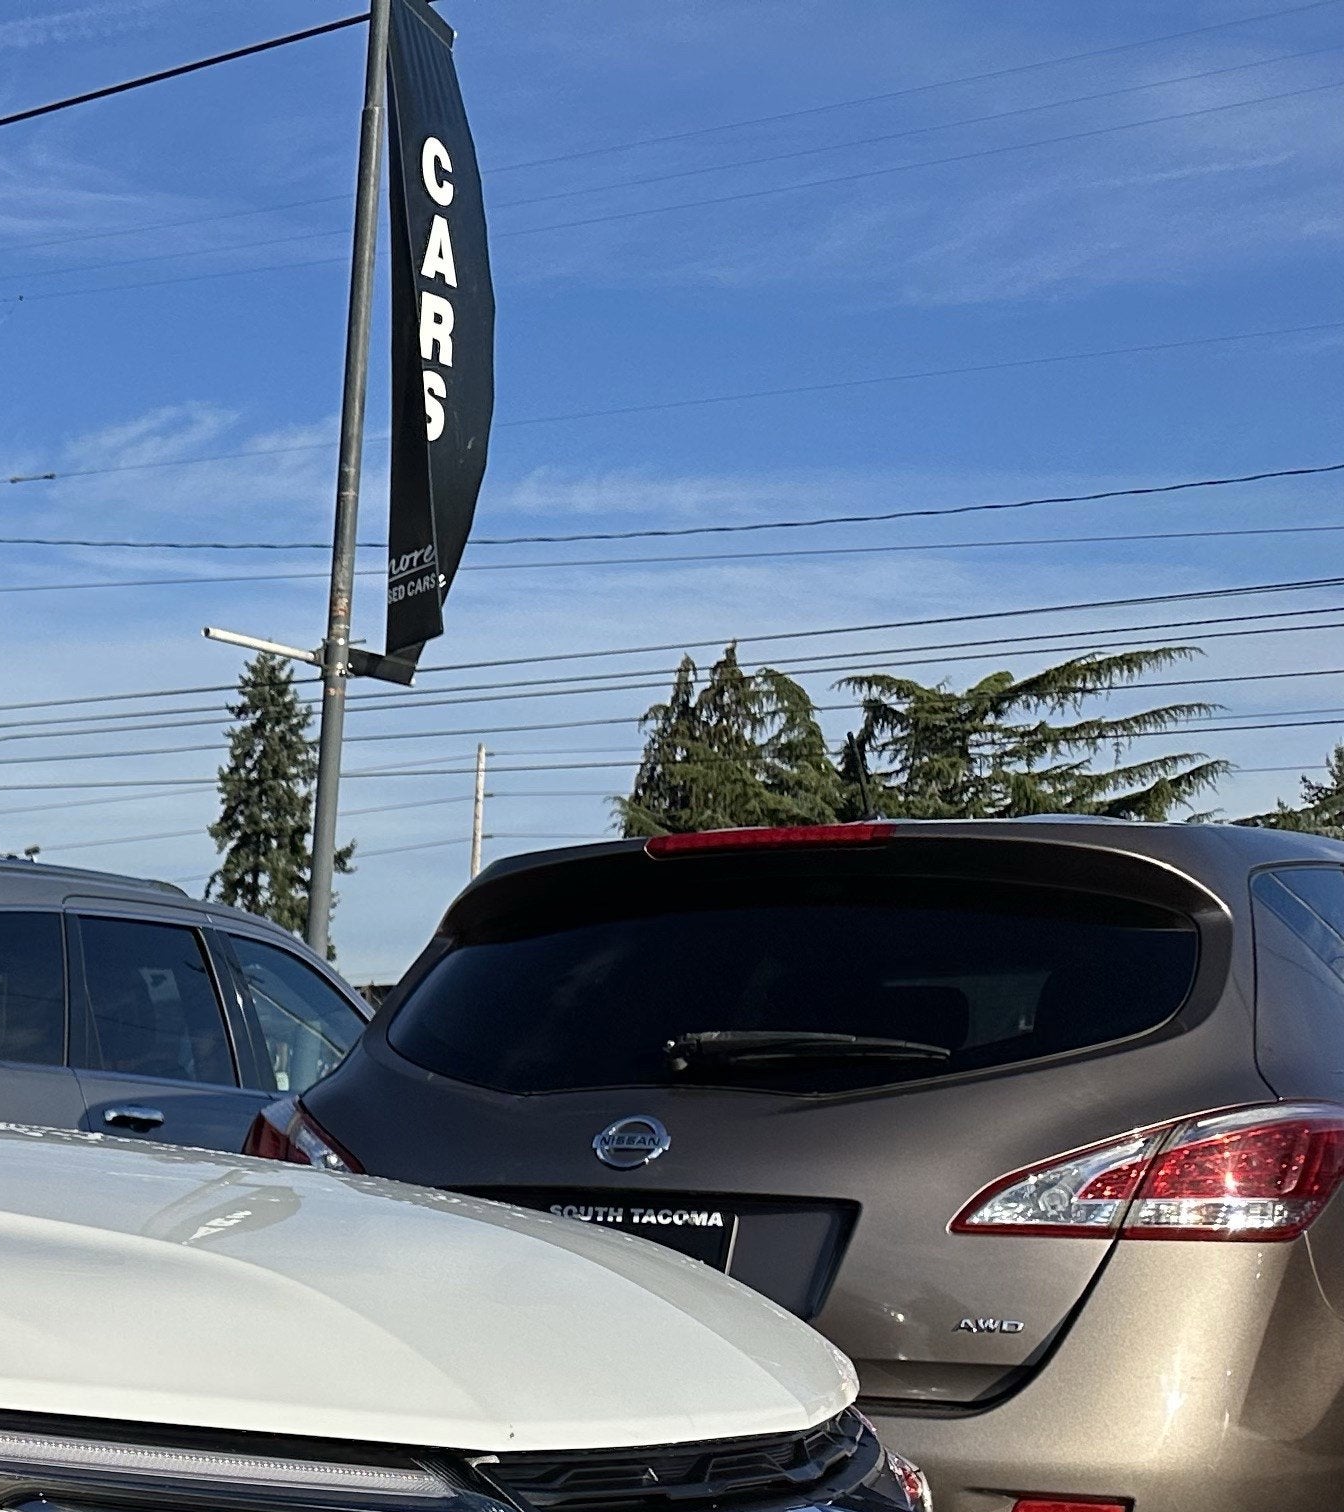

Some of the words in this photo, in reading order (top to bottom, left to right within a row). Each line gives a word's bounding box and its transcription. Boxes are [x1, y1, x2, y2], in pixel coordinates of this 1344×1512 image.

[420, 135, 458, 443] CARS
[407, 572, 436, 598] CARS
[599, 1134, 661, 1147] NISSAN
[549, 1204, 624, 1223] SOUTH
[630, 1207, 724, 1227] TACOMA
[951, 1318, 1025, 1334] AWD
